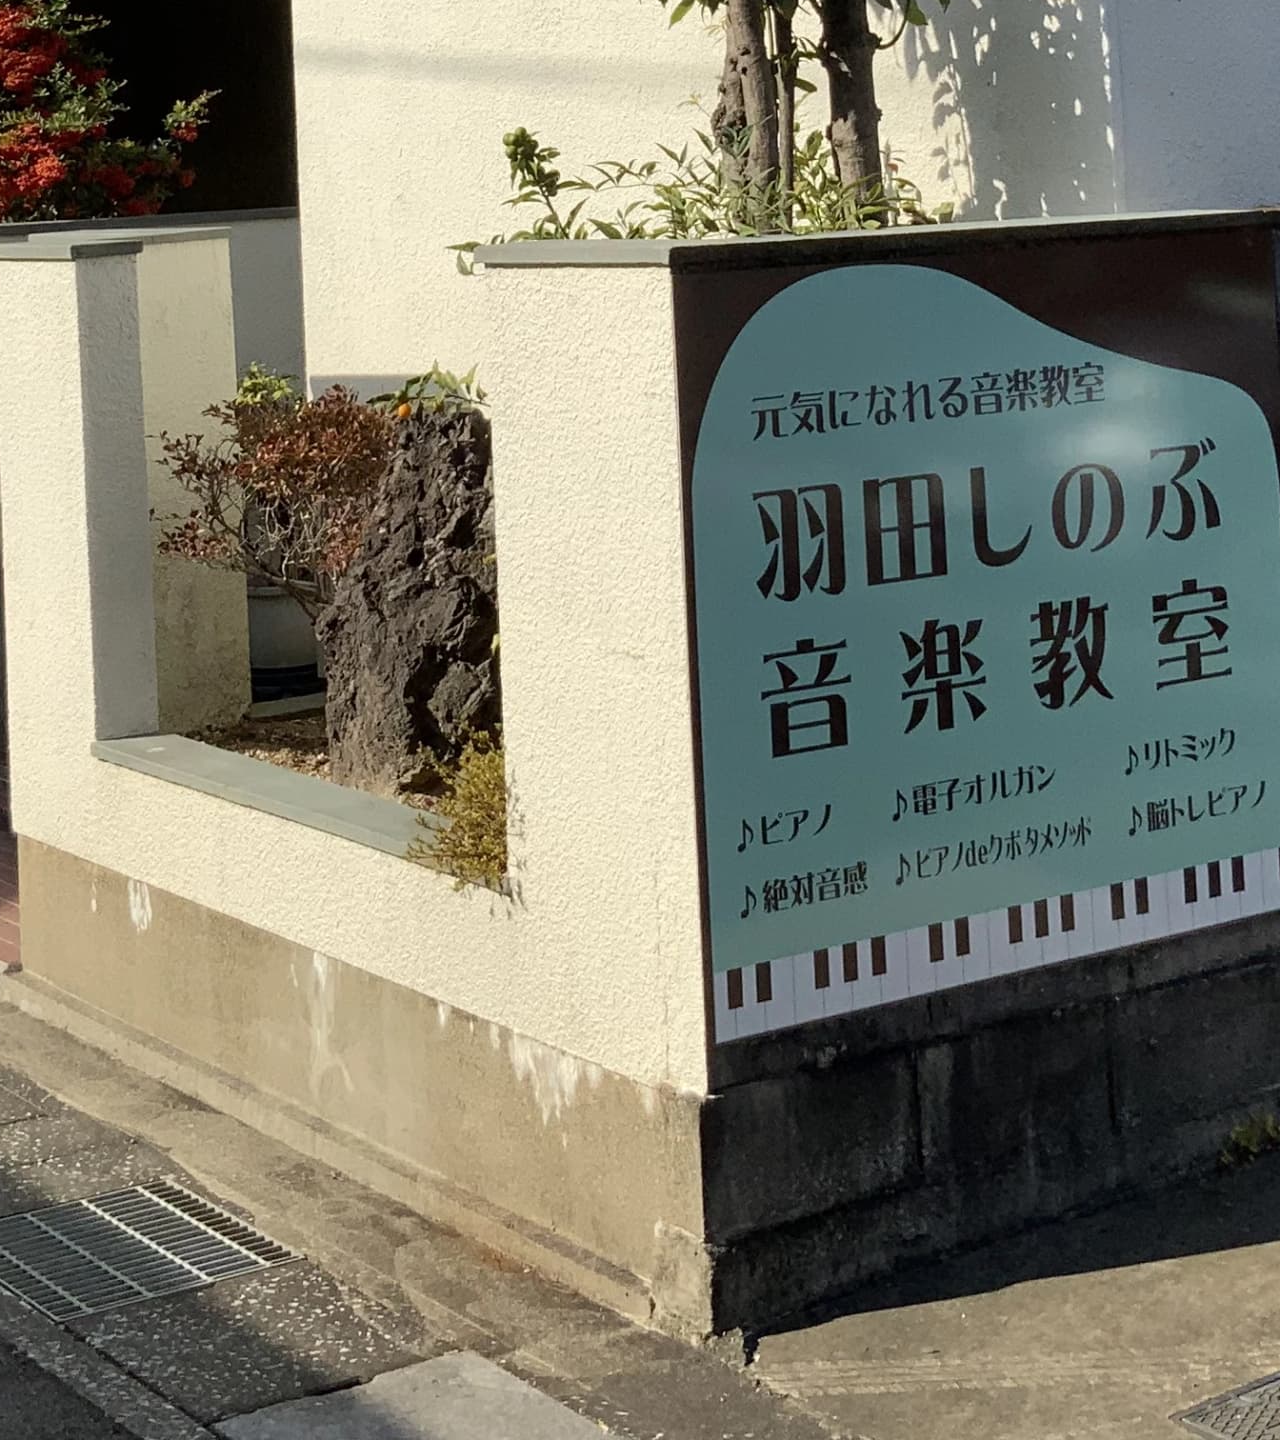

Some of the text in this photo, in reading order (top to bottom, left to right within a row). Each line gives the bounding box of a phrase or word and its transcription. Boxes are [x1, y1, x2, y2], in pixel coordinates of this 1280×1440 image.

[751, 361, 1106, 441] 元気になれる音楽教室
[752, 435, 1222, 602] 羽田しのぶ
[761, 578, 1233, 759] 音楽教室
[1143, 727, 1237, 770] リトミック
[912, 765, 1058, 816] 電子オルガン
[1146, 779, 1267, 833] 脳トレピアノ
[760, 803, 833, 846] ピアノ
[916, 816, 1092, 879] ピアノdeクボタメソッド
[762, 860, 870, 914] 絶対音感
